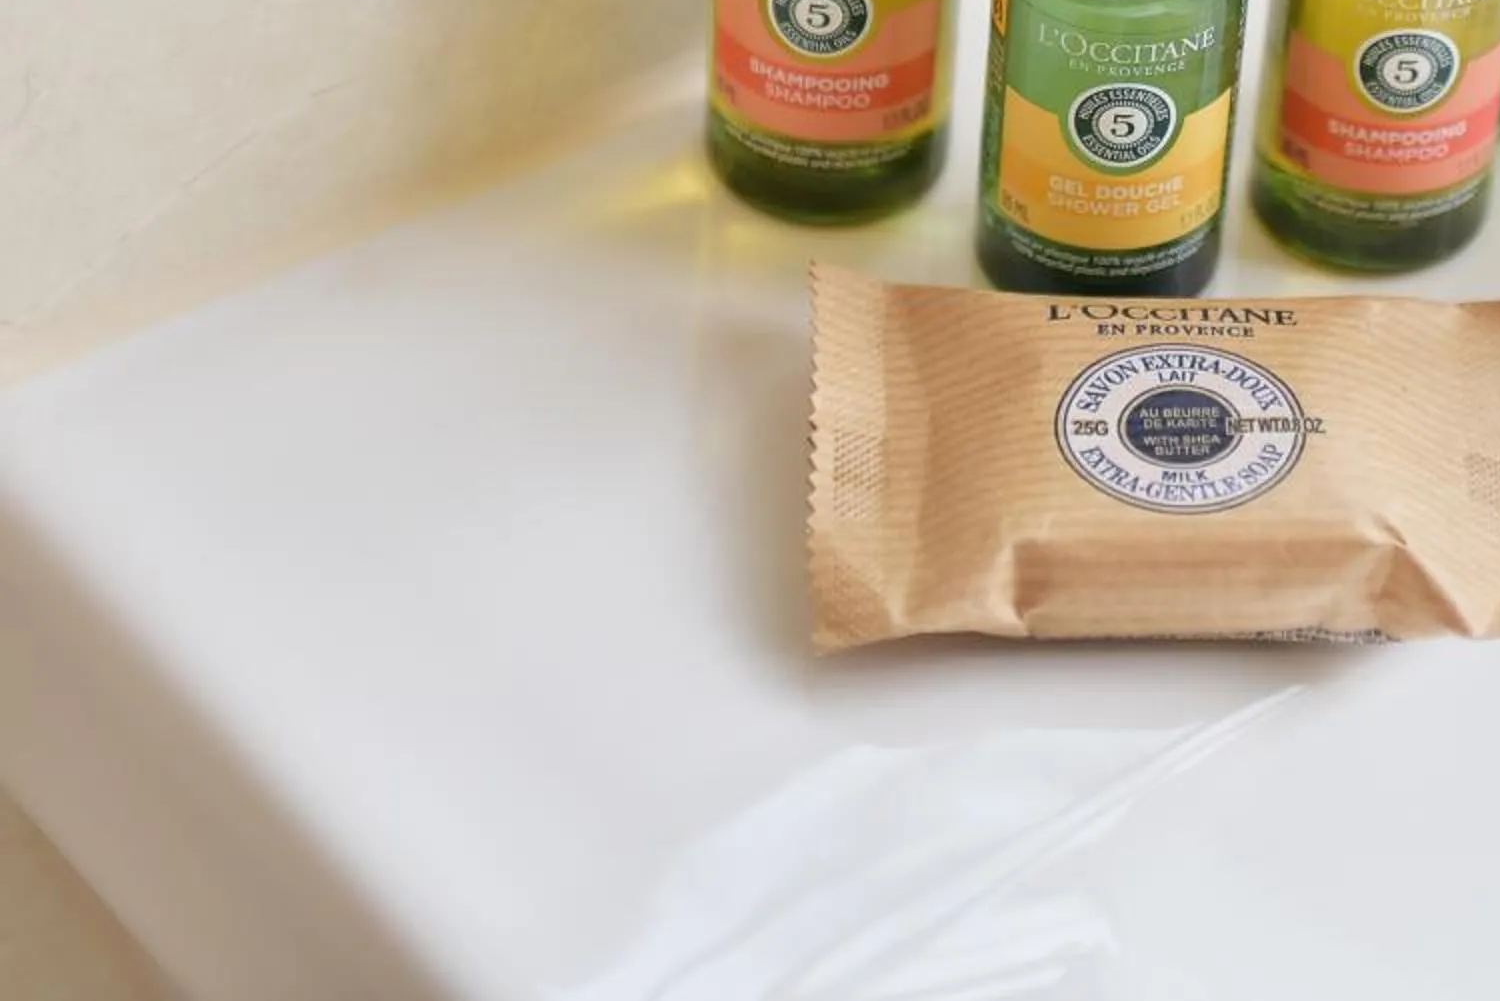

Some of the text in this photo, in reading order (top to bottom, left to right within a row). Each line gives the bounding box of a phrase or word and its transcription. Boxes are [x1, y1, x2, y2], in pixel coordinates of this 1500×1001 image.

[806, 2, 831, 28] 5
[1038, 22, 1216, 65] L'OCCITANE
[750, 61, 890, 93] SHAMPOOING
[1394, 61, 1420, 84] 5
[765, 82, 872, 110] SHAMPOO
[1110, 114, 1135, 137] 5
[1327, 119, 1467, 145] SHAMPOOING
[1343, 141, 1449, 160] SHAMPOO
[1049, 175, 1185, 200] GEL DOUCHE
[1047, 191, 1140, 217] SHOWER
[1145, 193, 1181, 213] GEL
[1048, 303, 1298, 327] L'OCCITANE
[1097, 323, 1255, 338] EN PROVENCE
[1076, 354, 1284, 413] SAVON EXTRA-DOUX
[1158, 371, 1198, 384] LAIT
[1140, 407, 1220, 418] AU BEURRE
[1073, 420, 1109, 437] 25G
[1225, 417, 1255, 435] NET
[1143, 434, 1221, 446] WITH SHEA
[1155, 446, 1210, 457] BUTTER
[1080, 444, 1285, 502] EXTRA-GENTLE SOAP
[1161, 470, 1209, 483] MILK
